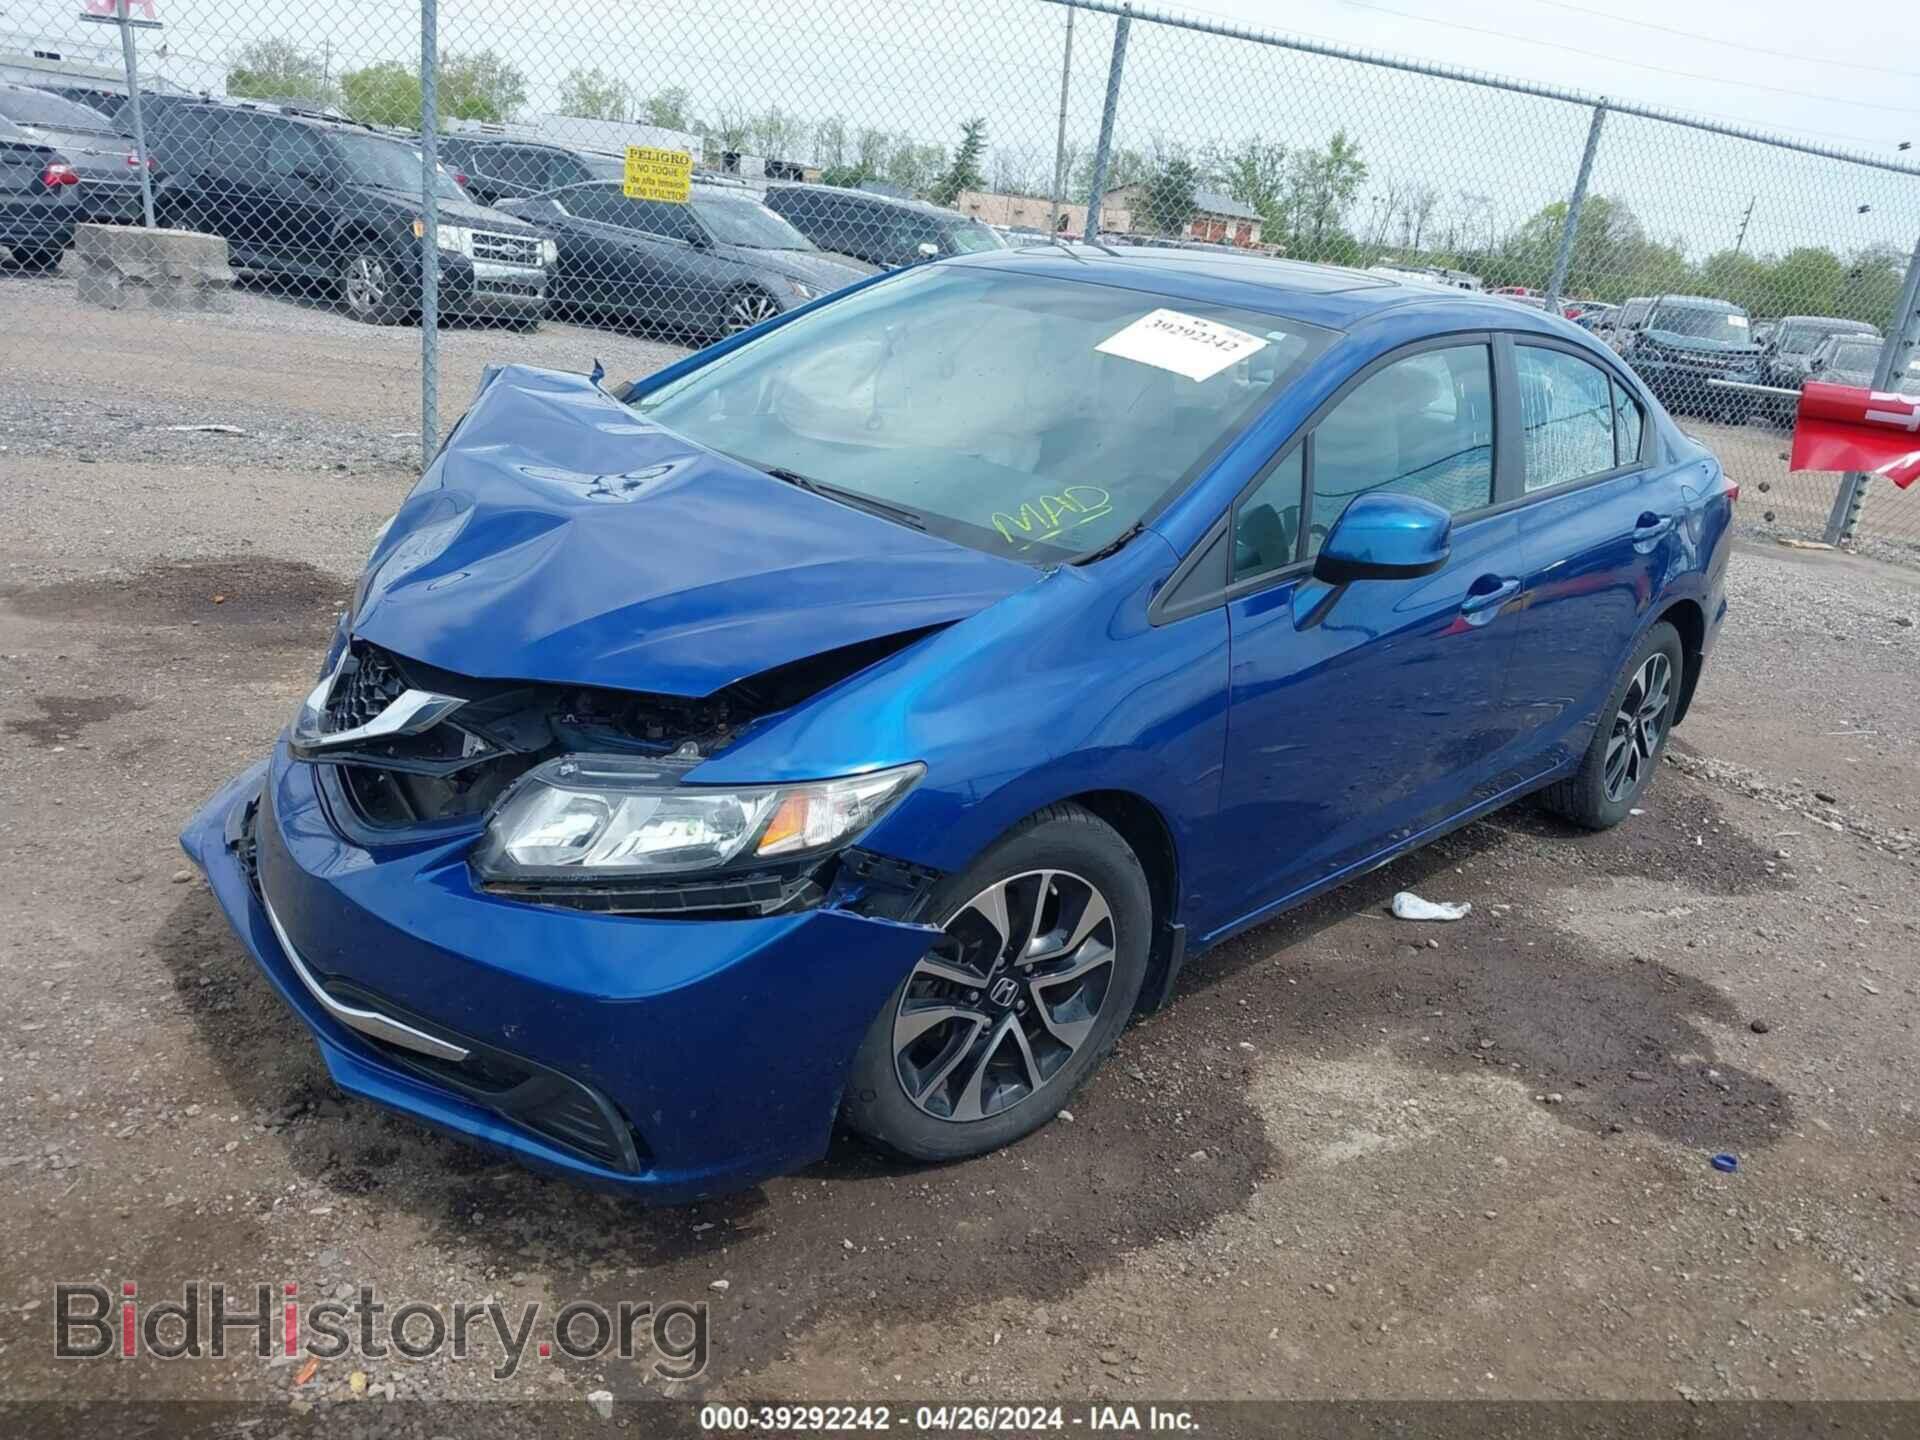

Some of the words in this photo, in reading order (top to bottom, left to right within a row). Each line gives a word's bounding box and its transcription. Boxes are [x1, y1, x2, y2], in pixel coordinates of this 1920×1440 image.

[629, 148, 689, 165] PELIGRO
[637, 163, 649, 174] NO
[651, 165, 678, 177] TOQUE
[991, 486, 1110, 543] MAD
